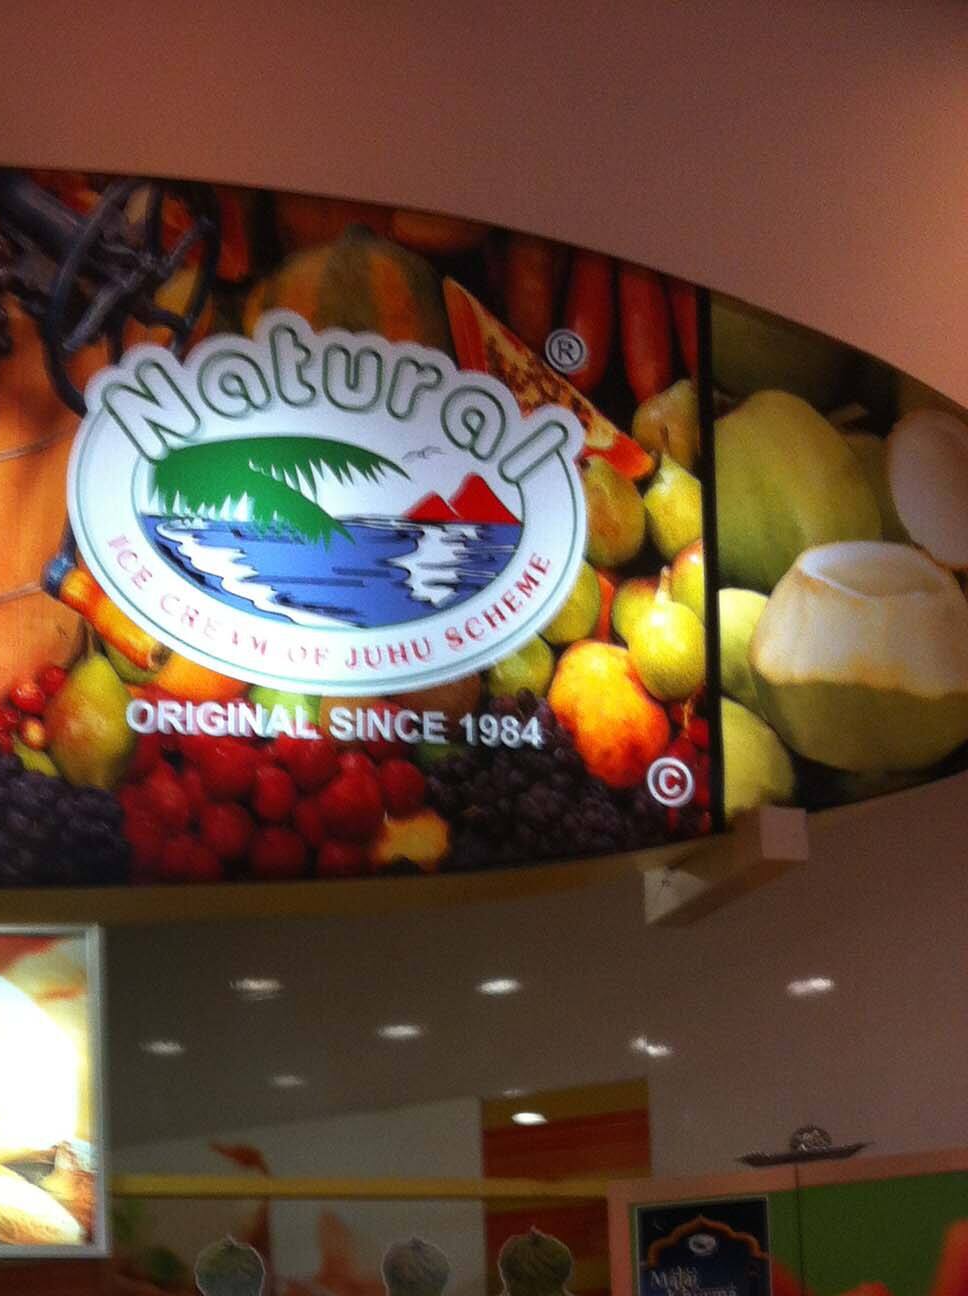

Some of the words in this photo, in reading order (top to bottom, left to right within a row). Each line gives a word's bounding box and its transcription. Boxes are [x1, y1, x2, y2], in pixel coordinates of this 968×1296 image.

[100, 322, 570, 486] Natural
[108, 535, 153, 590] ICE
[344, 637, 435, 670] JUHU
[445, 551, 551, 651] SCHEME
[125, 699, 322, 743] ORIGINAL
[328, 704, 448, 749] SINCE
[458, 714, 545, 753] 1984
